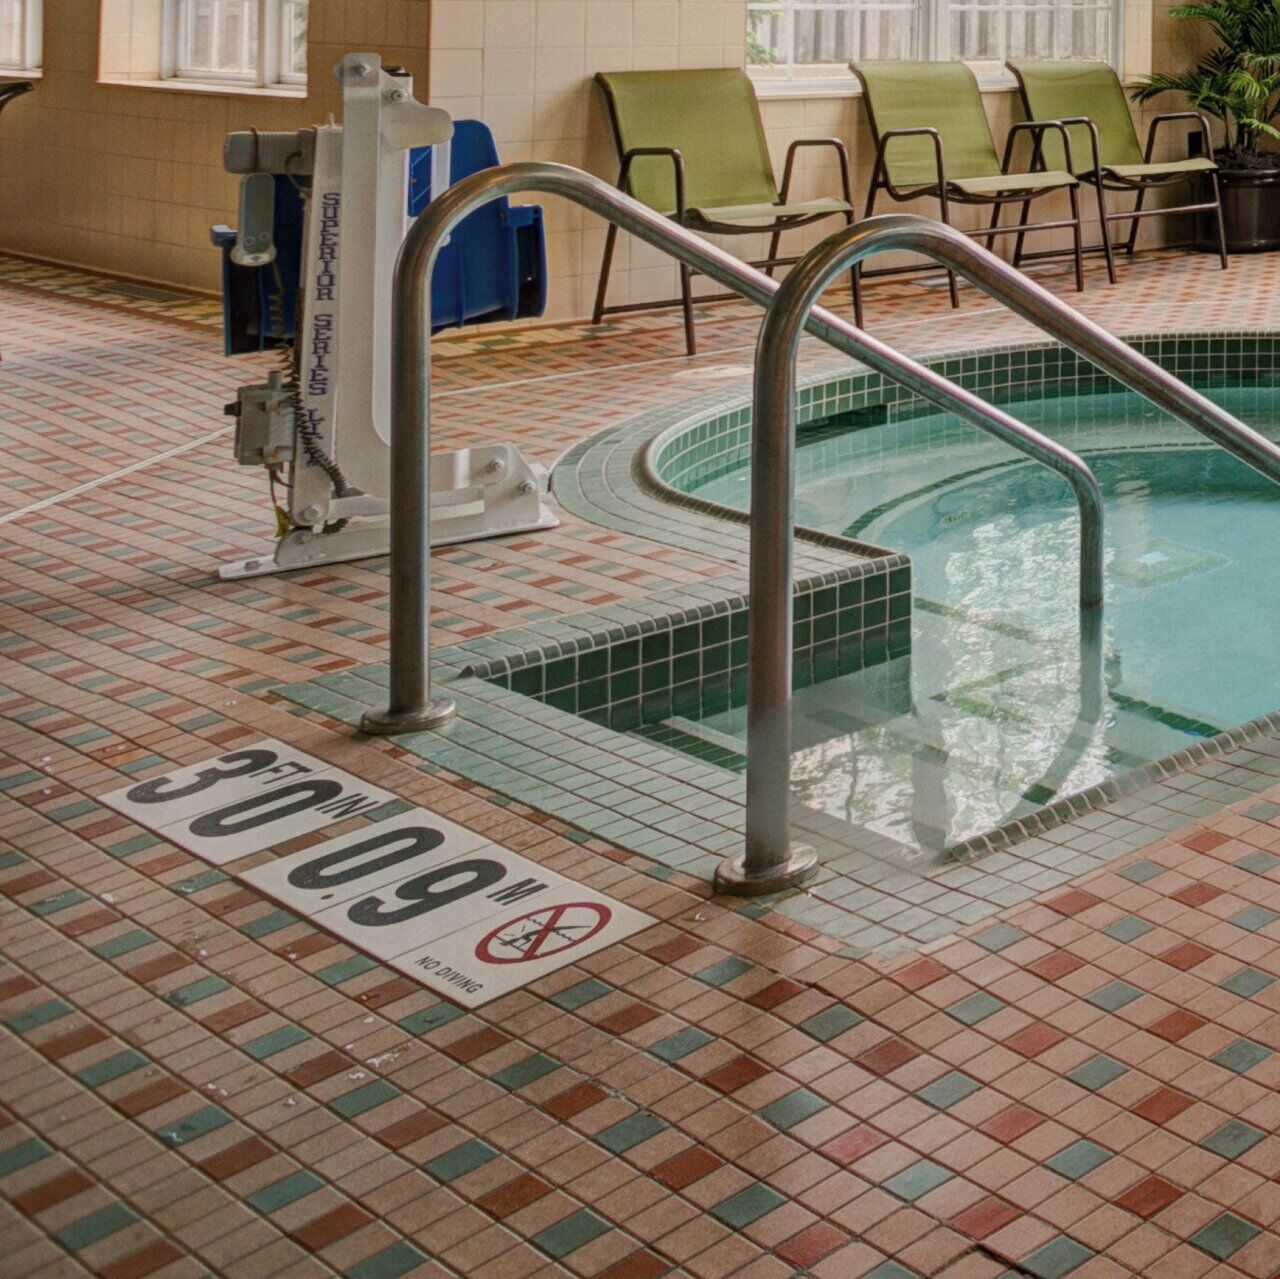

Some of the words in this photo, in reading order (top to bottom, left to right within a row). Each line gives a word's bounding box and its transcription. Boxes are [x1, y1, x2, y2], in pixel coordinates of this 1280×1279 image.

[316, 192, 341, 301] SUPERIOR
[308, 314, 333, 396] SERIES
[126, 748, 280, 804] 3
[250, 761, 313, 786] FT
[315, 792, 379, 820] IN
[287, 826, 508, 928] 0.9
[486, 877, 549, 906] M
[415, 955, 440, 974] NO
[434, 963, 485, 996] DIVING
